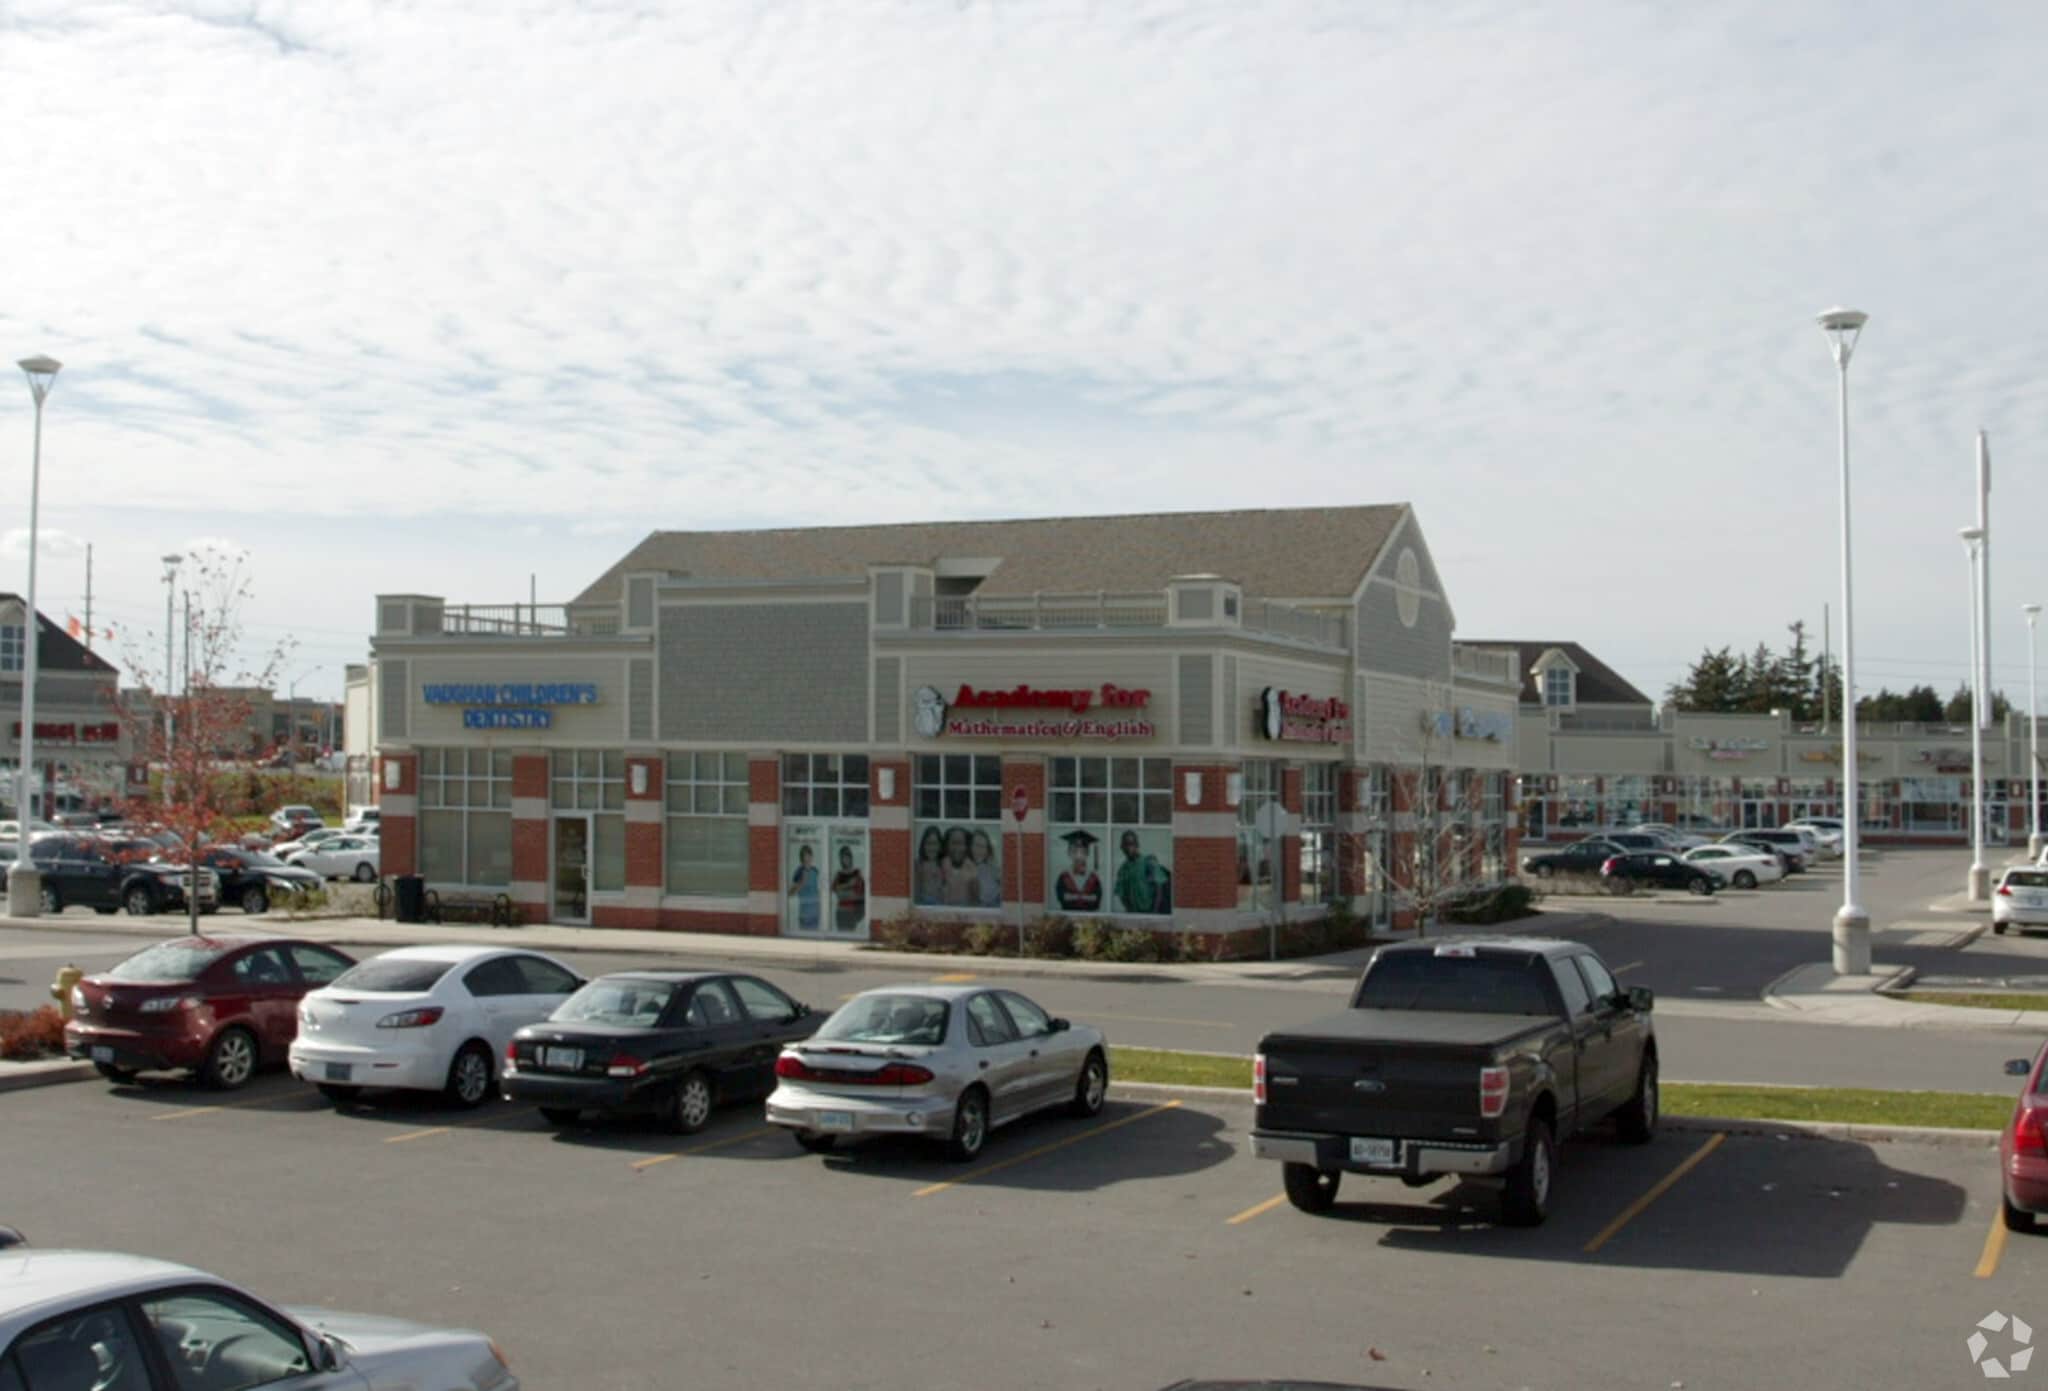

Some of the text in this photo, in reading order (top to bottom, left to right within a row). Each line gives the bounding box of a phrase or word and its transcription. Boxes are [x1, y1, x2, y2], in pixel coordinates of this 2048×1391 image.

[952, 683, 1093, 714] Academy
[463, 709, 552, 729] DENTISTRY
[950, 720, 1060, 737] Mathematics
[1082, 720, 1152, 741] English
